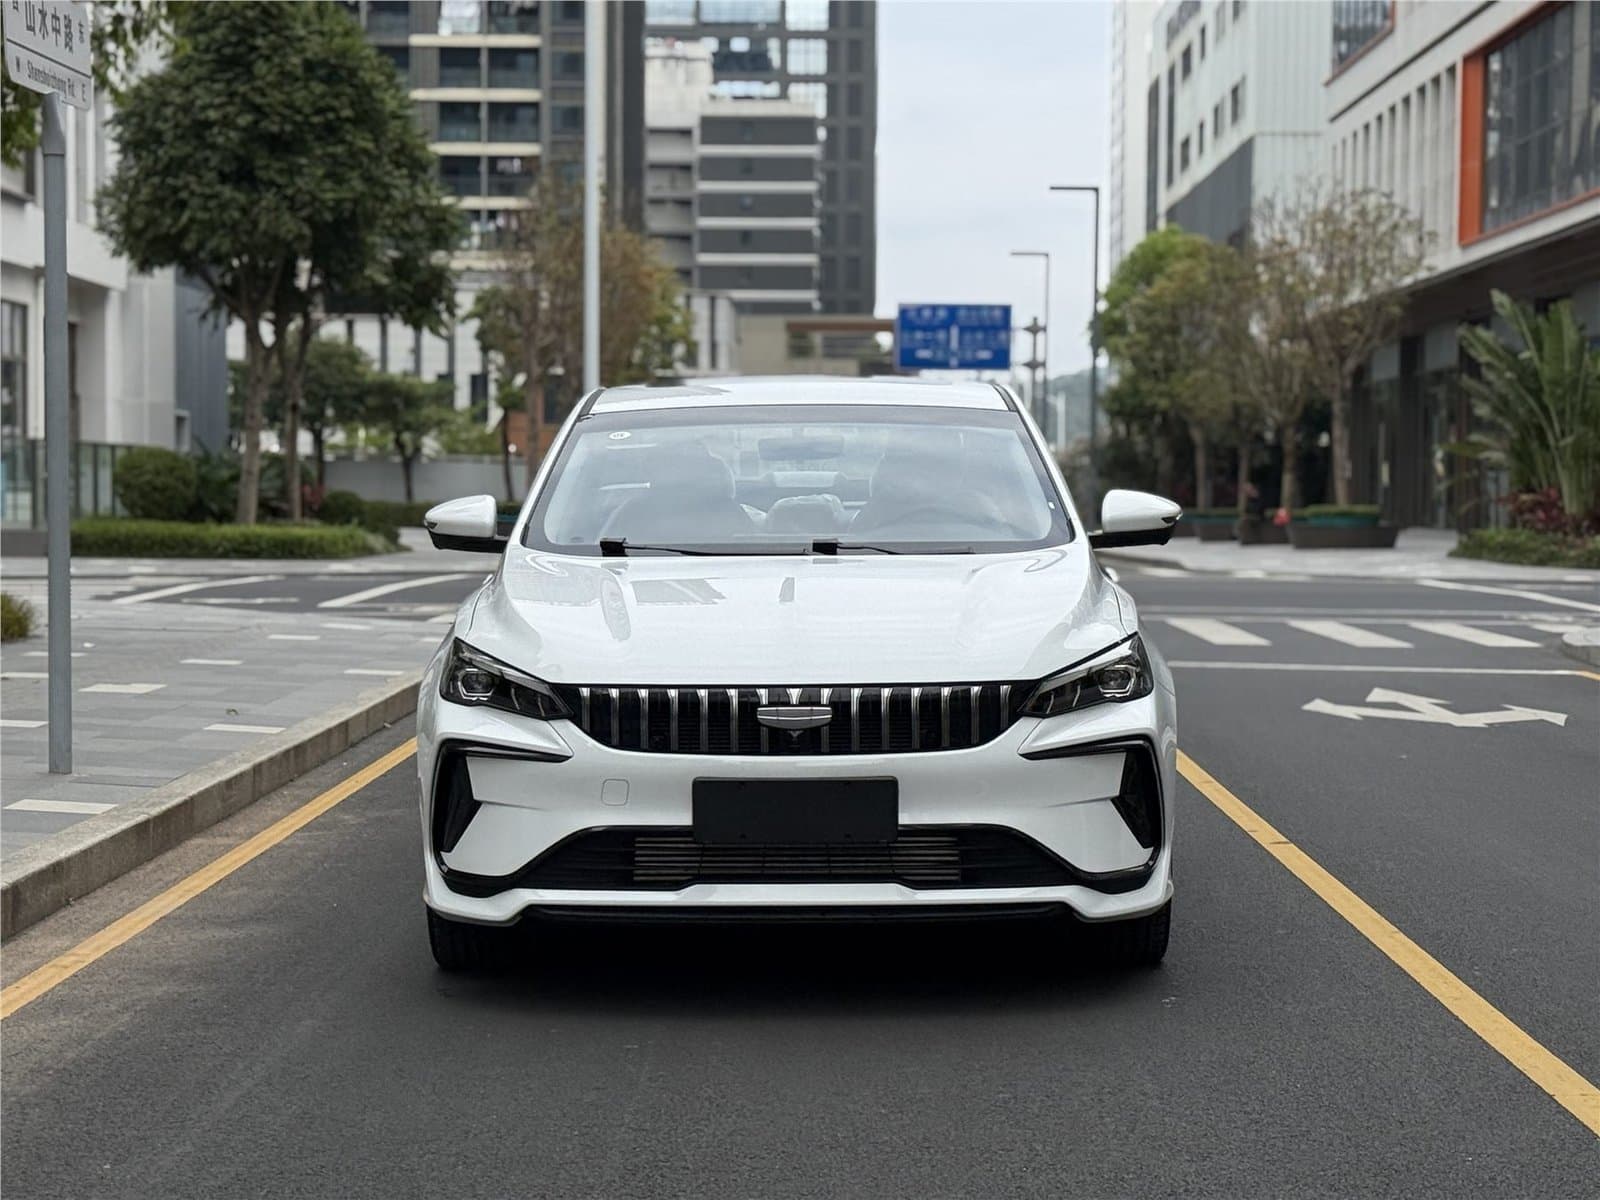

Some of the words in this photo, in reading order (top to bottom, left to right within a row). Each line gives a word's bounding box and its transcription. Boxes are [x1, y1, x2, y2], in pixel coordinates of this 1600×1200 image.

[25, 0, 73, 54] 山水中路
[81, 83, 87, 102] E
